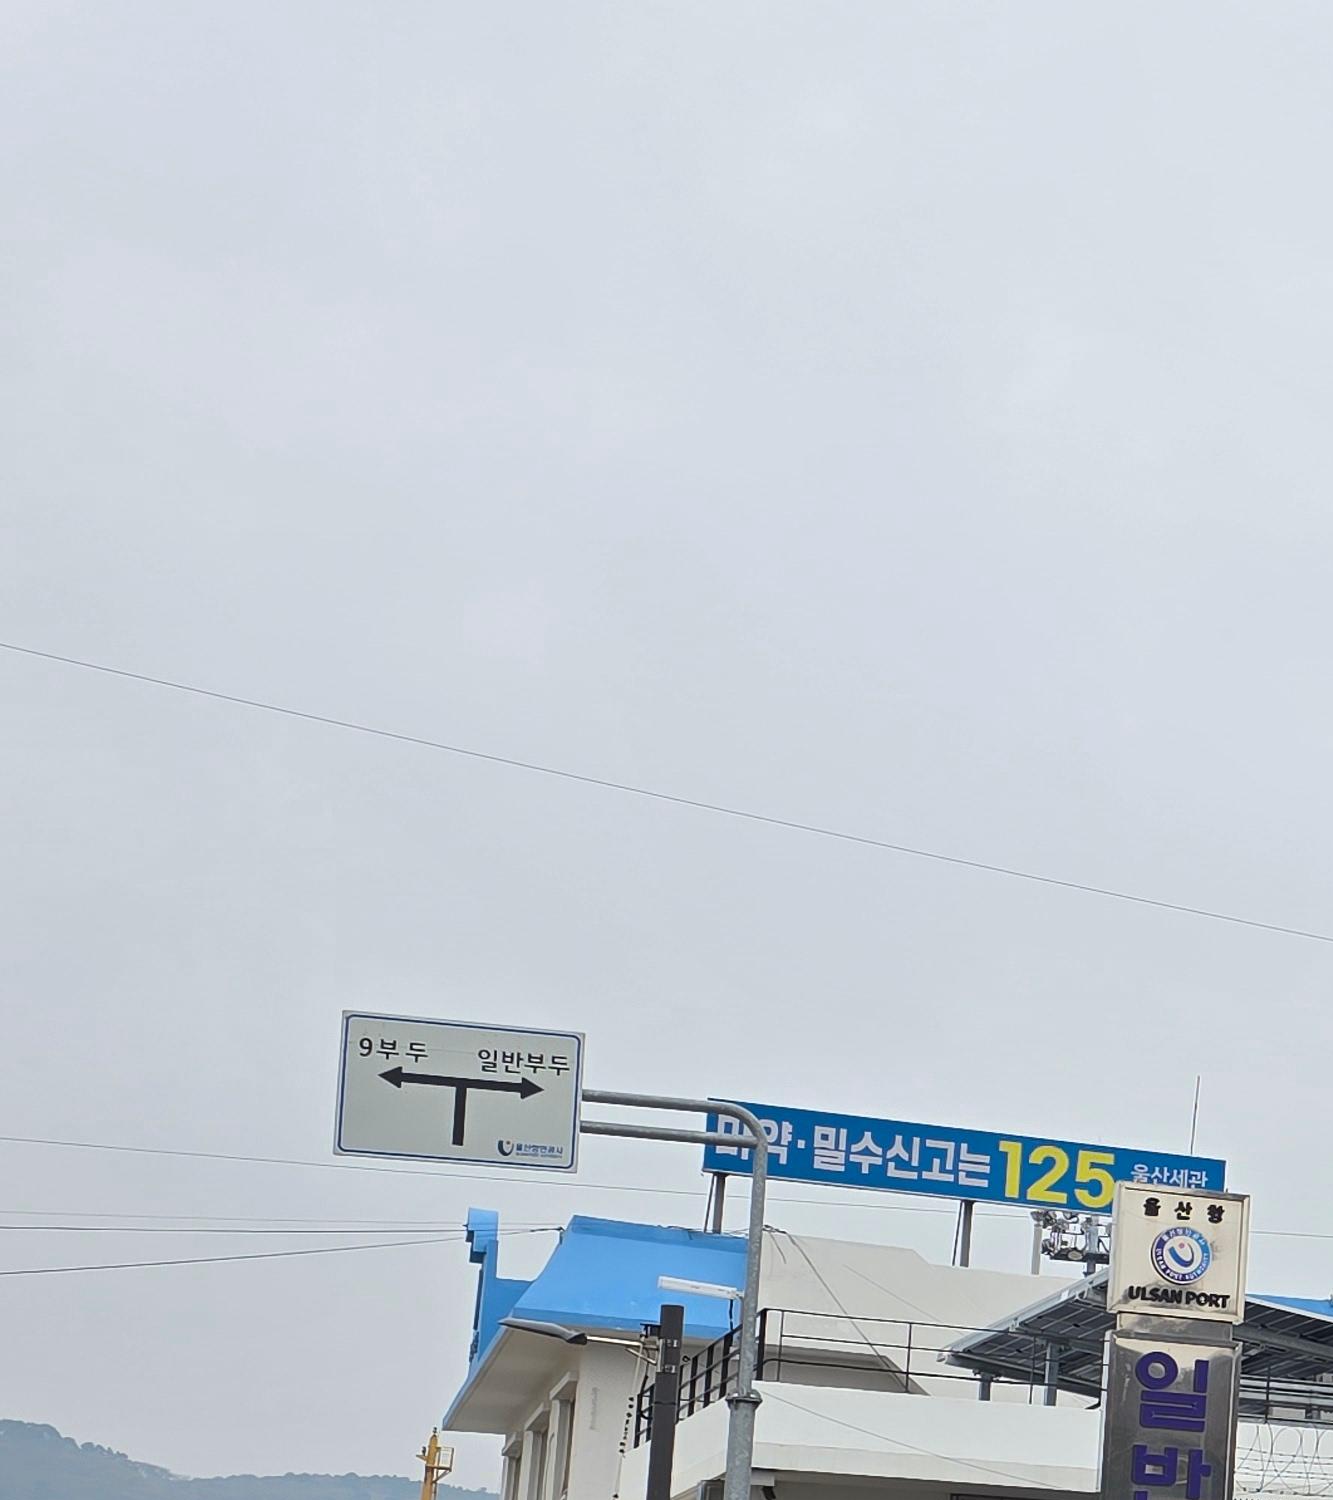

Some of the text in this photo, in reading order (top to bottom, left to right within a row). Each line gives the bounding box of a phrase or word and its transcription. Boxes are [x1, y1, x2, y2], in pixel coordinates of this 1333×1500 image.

[478, 1049, 570, 1077] 일반부두
[998, 1140, 1115, 1208] 125
[1128, 1285, 1230, 1308] ULSAN PORT
